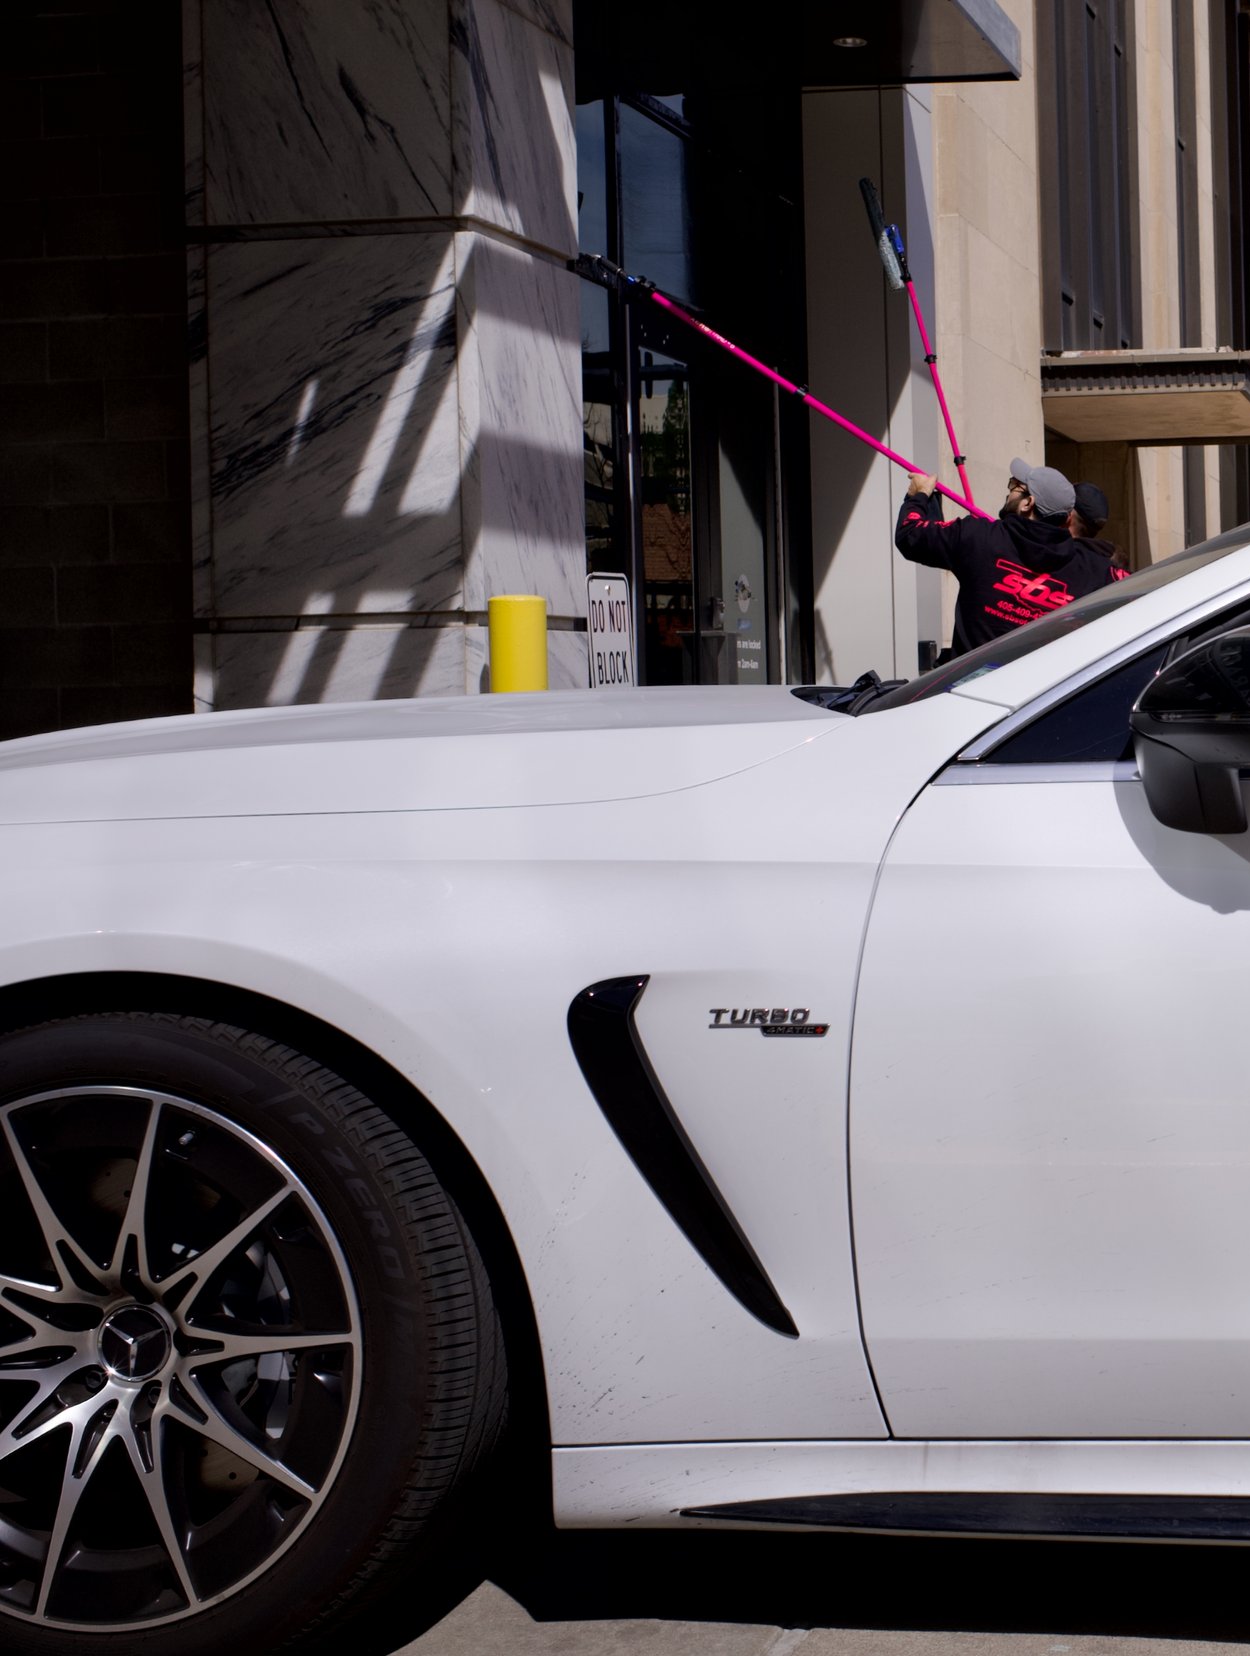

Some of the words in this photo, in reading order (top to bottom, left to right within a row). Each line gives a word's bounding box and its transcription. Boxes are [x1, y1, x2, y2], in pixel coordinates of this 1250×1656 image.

[992, 573, 1075, 610] sbs
[591, 600, 605, 633] DO
[608, 600, 627, 633] NOT
[597, 651, 630, 685] BLOCK
[709, 1008, 811, 1025] TURBO
[322, 1146, 406, 1280] ZERO
